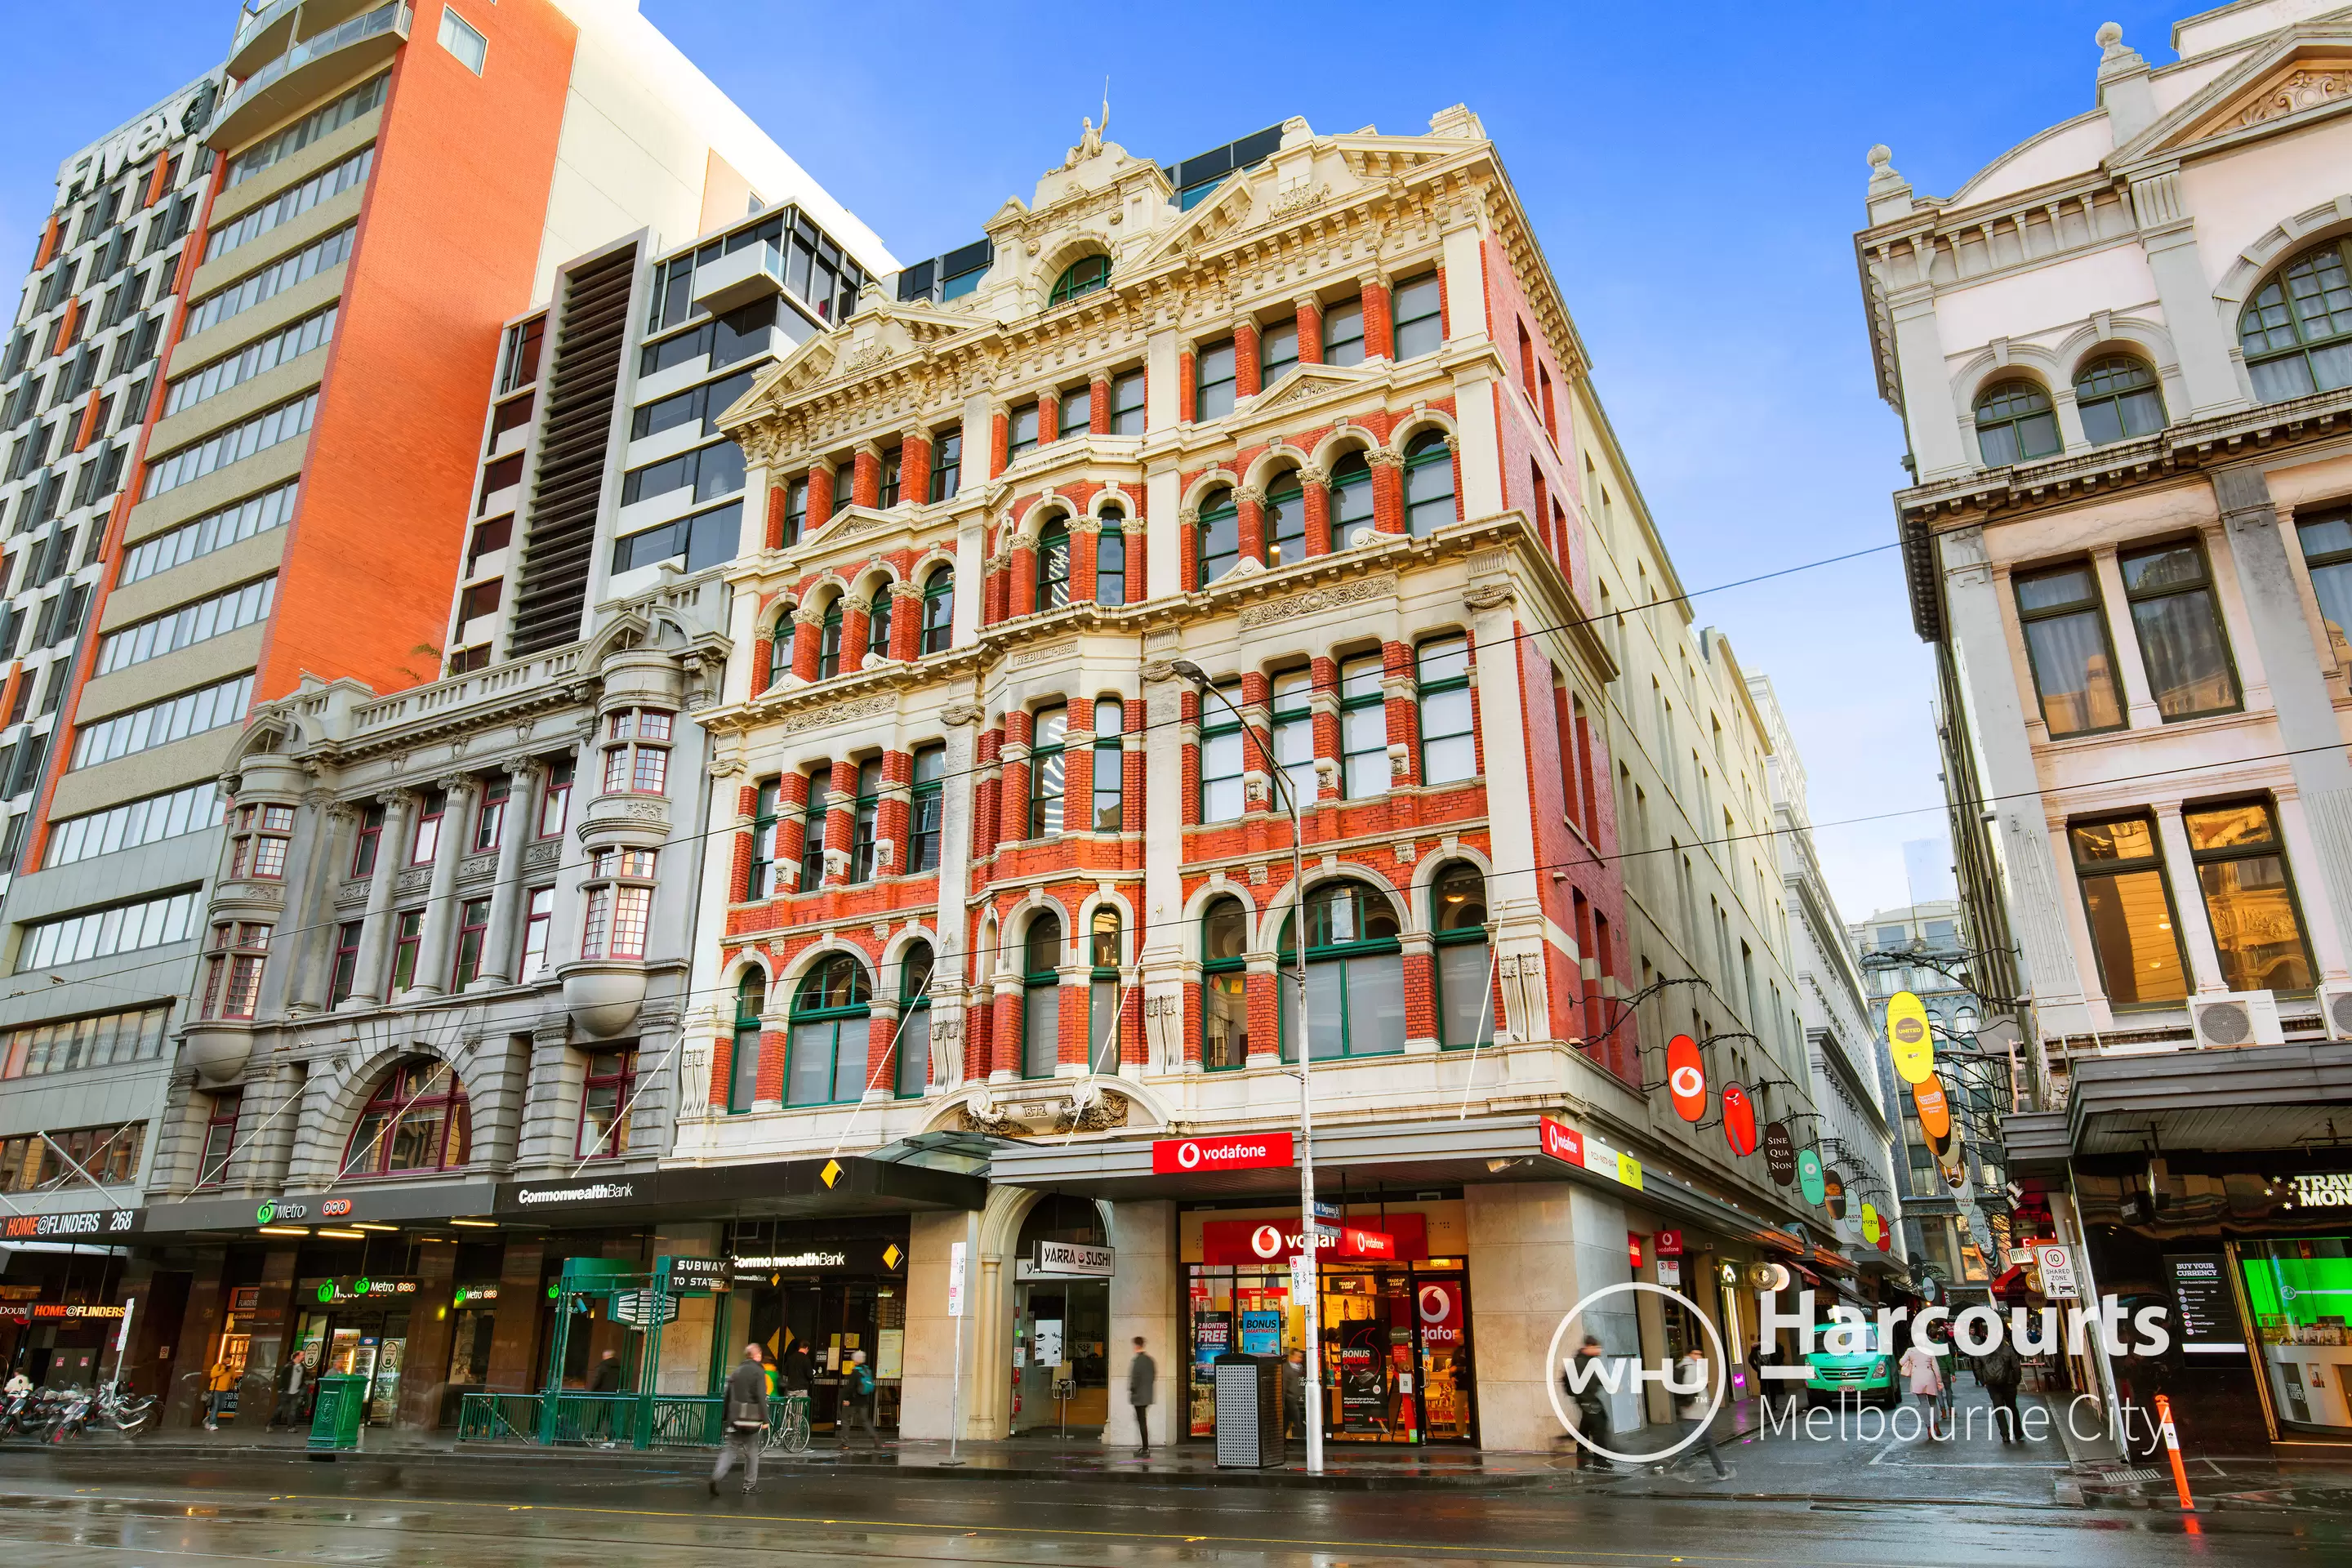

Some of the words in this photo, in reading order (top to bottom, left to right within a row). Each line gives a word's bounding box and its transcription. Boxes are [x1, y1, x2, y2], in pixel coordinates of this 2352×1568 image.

[1022, 1105, 1048, 1118] 1872
[1557, 1135, 1578, 1153] vodafone
[1767, 1137, 1788, 1145] SINE
[1203, 1143, 1266, 1160] vodafone
[1770, 1149, 1790, 1158] QUA
[276, 1204, 305, 1218] Metro
[7, 1212, 100, 1236] HOME@FLINDERS
[109, 1210, 133, 1232] 268
[1365, 1238, 1384, 1250] vodafone
[1045, 1247, 1076, 1264] YARRA
[1086, 1251, 1111, 1267] SUSHI
[2050, 1254, 2060, 1262] 10
[677, 1260, 726, 1274] SUBWAY
[371, 1281, 394, 1292] Metro
[674, 1276, 685, 1285] TO
[690, 1277, 712, 1286] STAT
[466, 1290, 482, 1298] Metro
[34, 1305, 125, 1318] HOME@FLINDERS
[1246, 1320, 1276, 1328] BONUS
[1197, 1330, 1228, 1343] FREE
